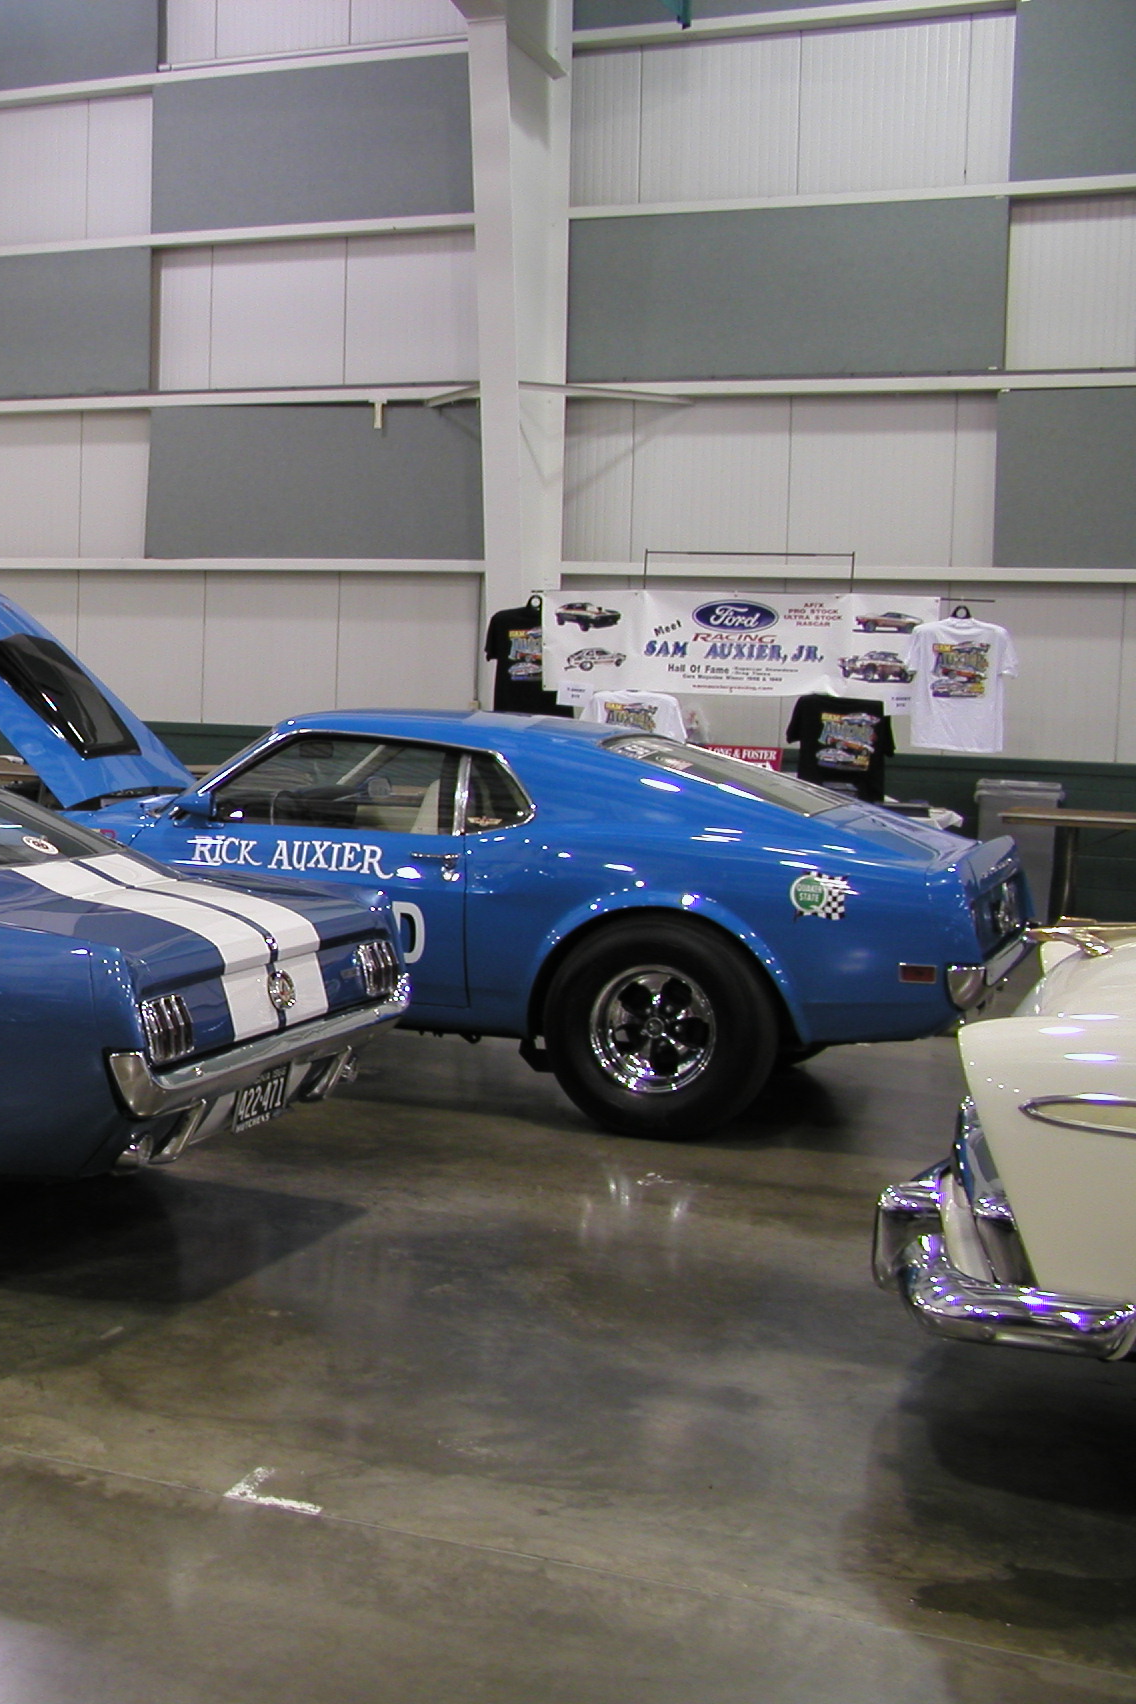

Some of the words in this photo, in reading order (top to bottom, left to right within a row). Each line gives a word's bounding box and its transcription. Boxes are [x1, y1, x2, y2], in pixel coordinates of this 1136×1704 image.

[709, 605, 759, 628] Ford
[654, 619, 682, 637] Meet
[692, 632, 777, 644] RACING
[643, 640, 689, 658] SAM
[703, 642, 788, 664] AUXIER,
[667, 663, 686, 673] Hall
[690, 664, 701, 673] Of
[704, 665, 730, 674] Fame
[733, 748, 740, 759] &
[742, 749, 777, 760] FOSTER
[191, 835, 263, 866] RICK
[267, 840, 394, 880] AUXIER
[796, 883, 823, 893] QUAKER
[799, 893, 820, 902] STATE
